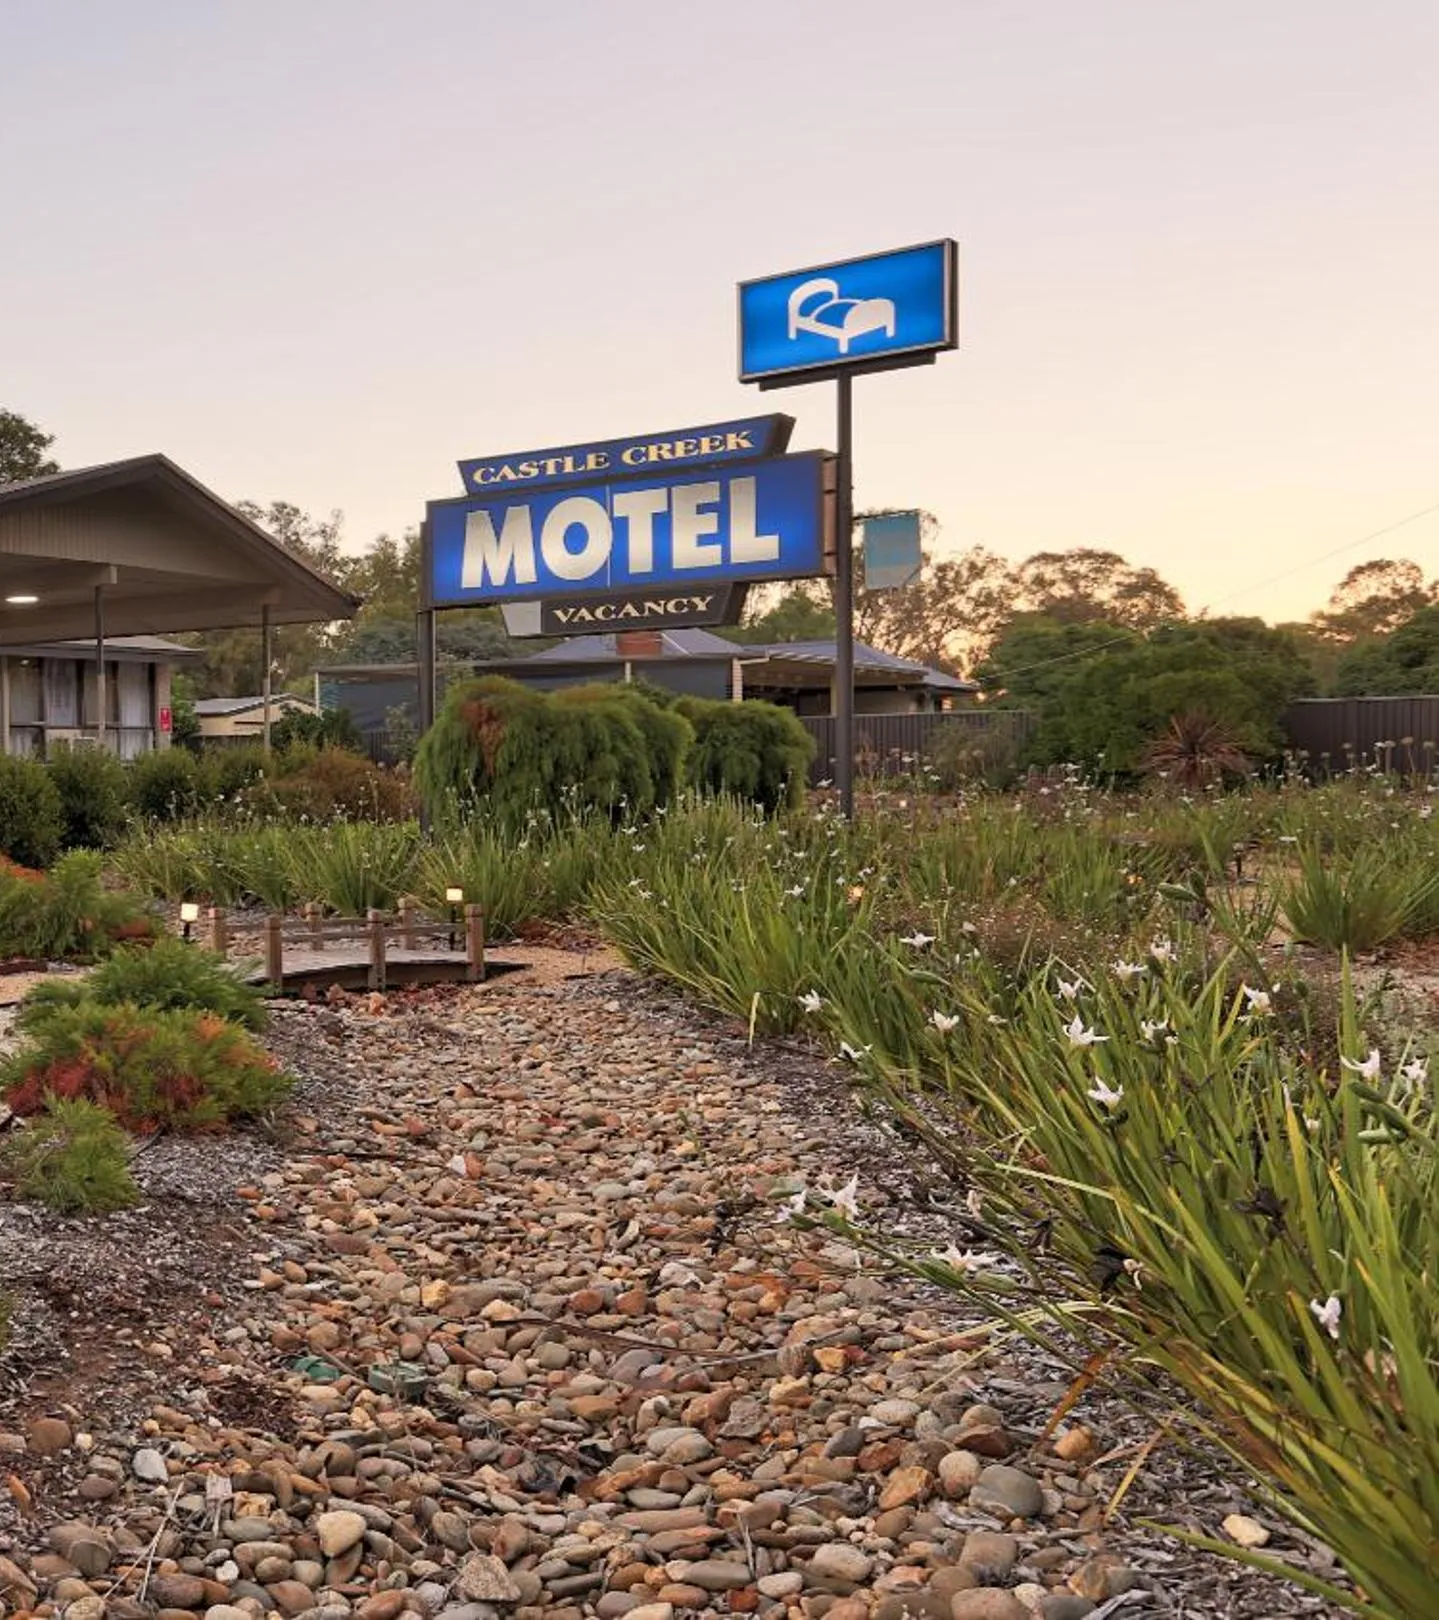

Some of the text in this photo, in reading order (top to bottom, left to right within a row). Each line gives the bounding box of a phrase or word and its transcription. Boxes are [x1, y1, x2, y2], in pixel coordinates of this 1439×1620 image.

[472, 430, 754, 485] CASTLE CREEK
[461, 477, 780, 589] MOTEL
[553, 596, 713, 623] VACANCY
